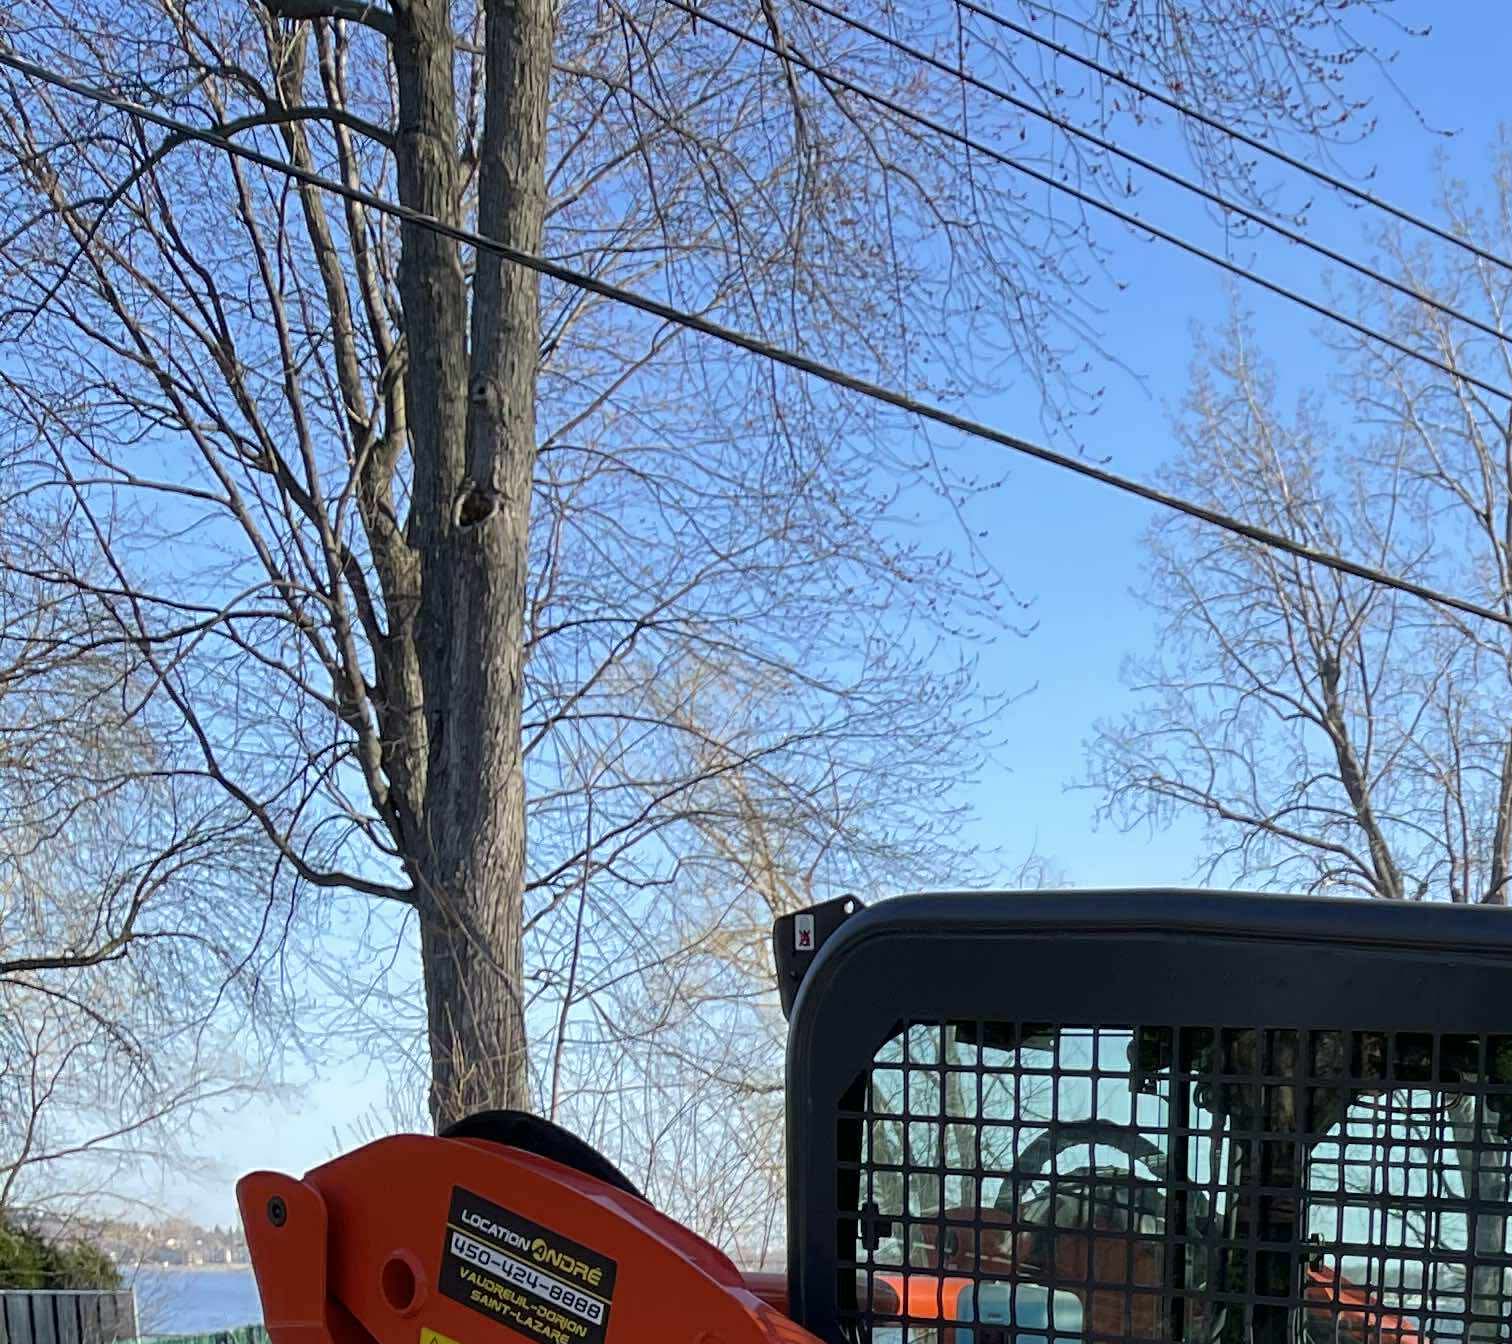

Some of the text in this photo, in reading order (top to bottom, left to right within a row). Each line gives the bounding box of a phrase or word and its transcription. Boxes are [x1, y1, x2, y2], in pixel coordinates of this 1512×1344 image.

[461, 1208, 531, 1252] LOCATION
[454, 1237, 601, 1320] 450-424-8888
[459, 1266, 588, 1337] VAUDREUIL-DORION
